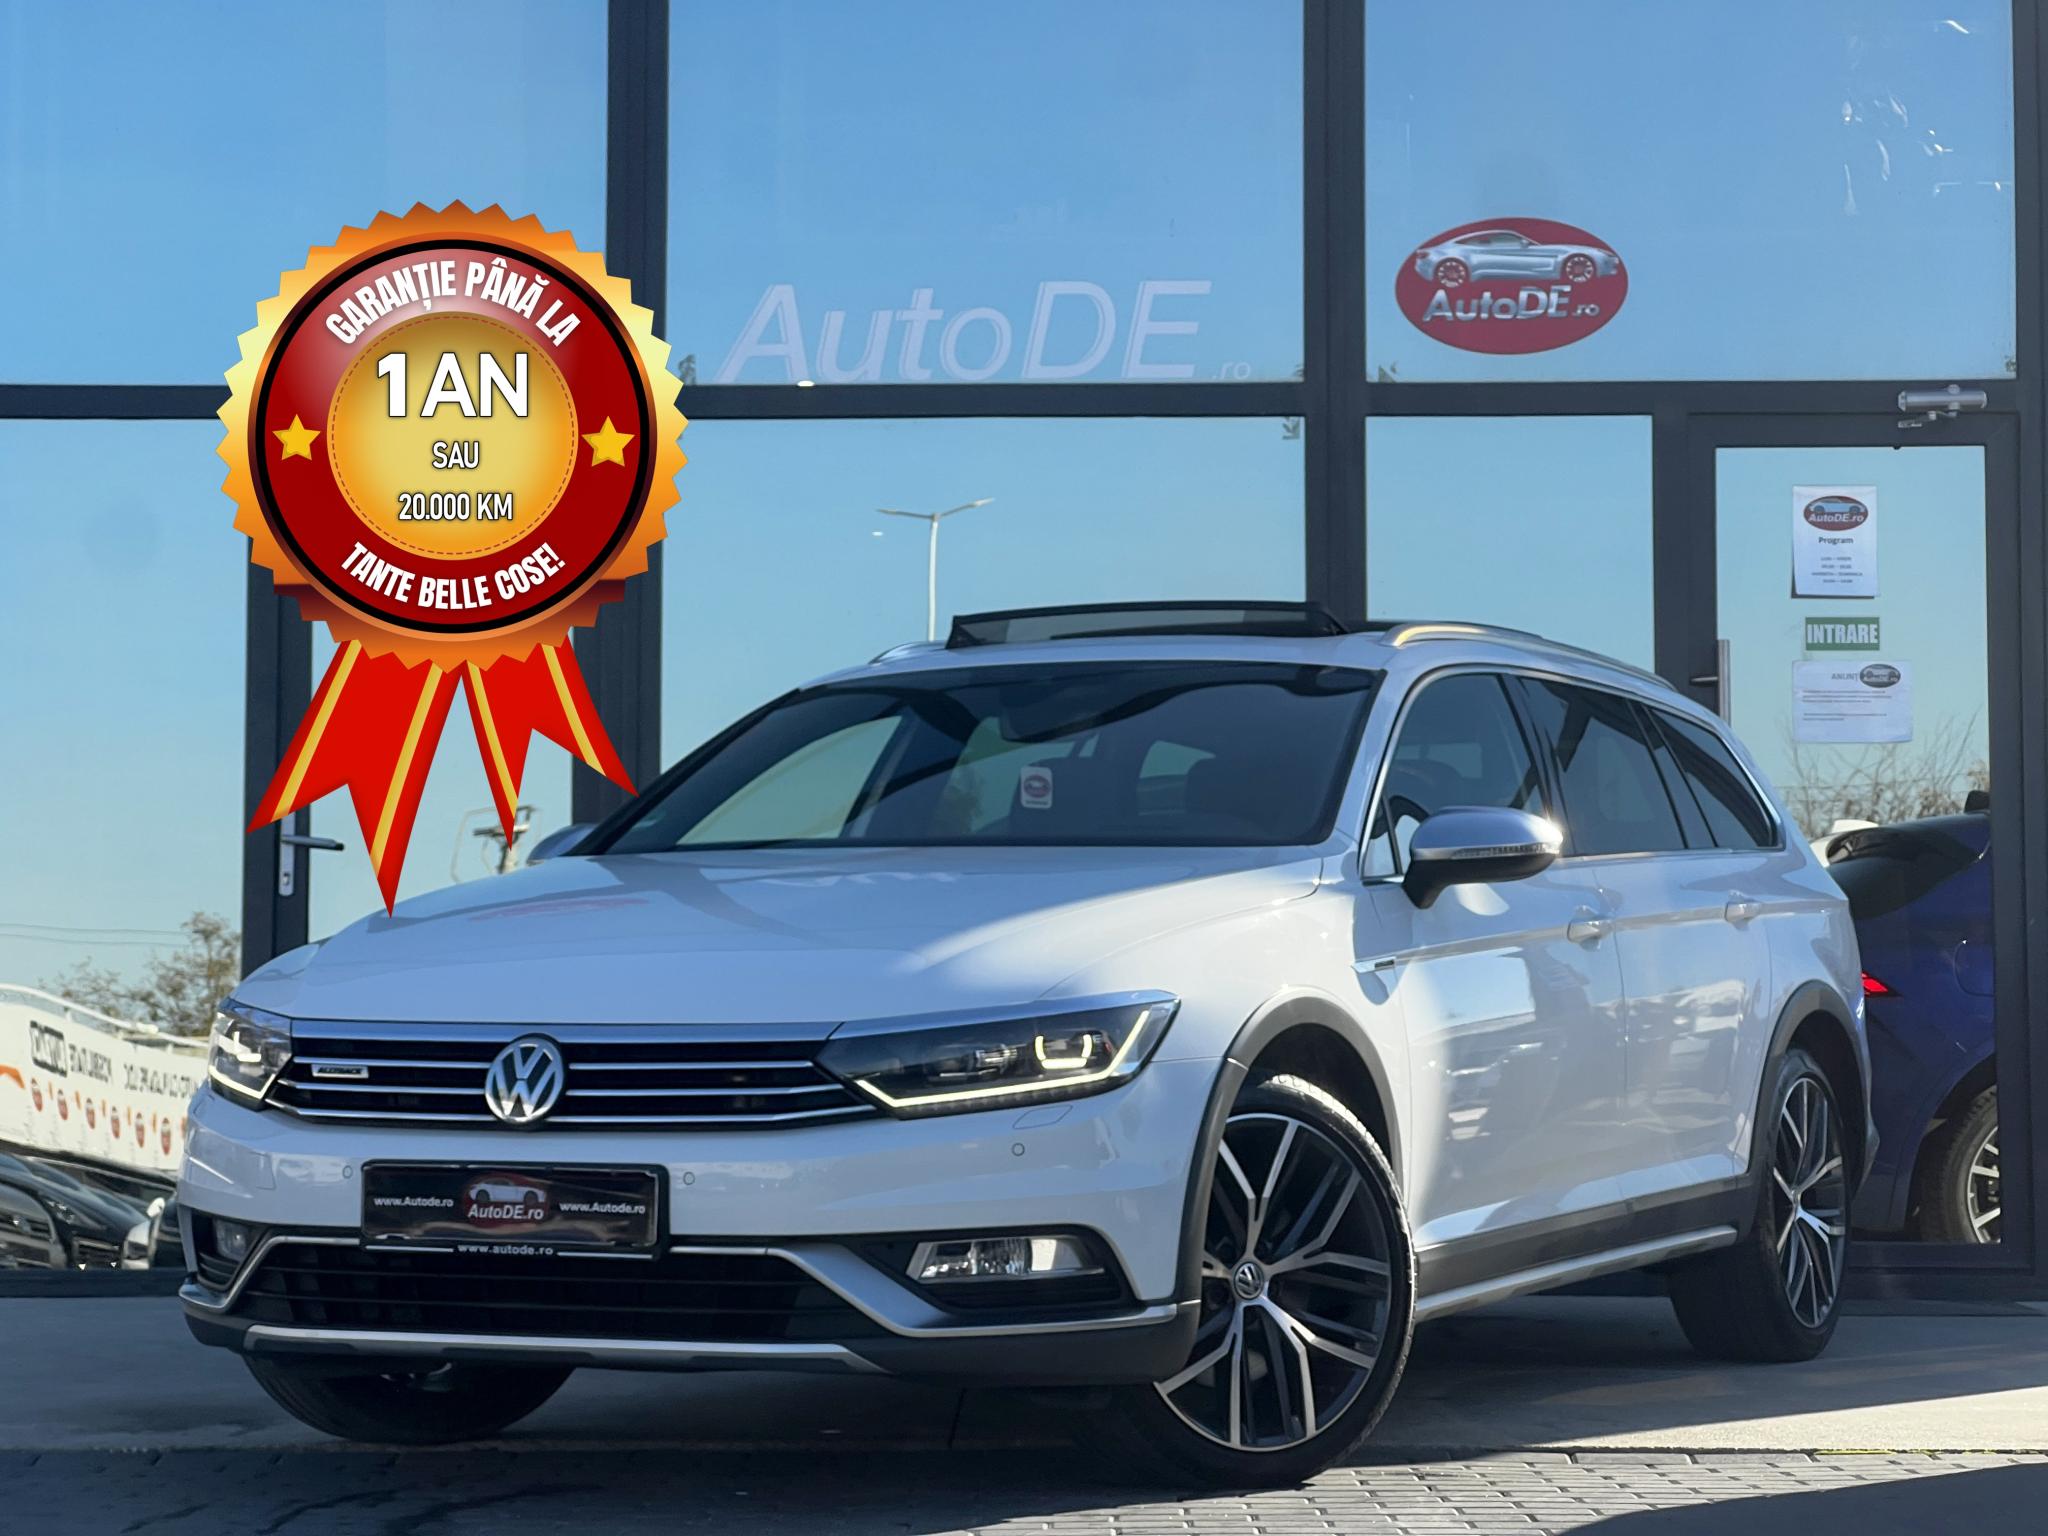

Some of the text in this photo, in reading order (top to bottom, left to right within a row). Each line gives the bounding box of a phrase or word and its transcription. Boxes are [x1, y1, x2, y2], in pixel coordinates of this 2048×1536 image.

[1818, 537, 1854, 546] Program
[1806, 623, 1879, 644] INTRARE
[373, 1196, 454, 1208] www.Autode.ro
[467, 1203, 544, 1220] AutoDE.ro
[559, 1202, 646, 1215] www.Autode.ro
[457, 1244, 554, 1256] www.autode.ro
